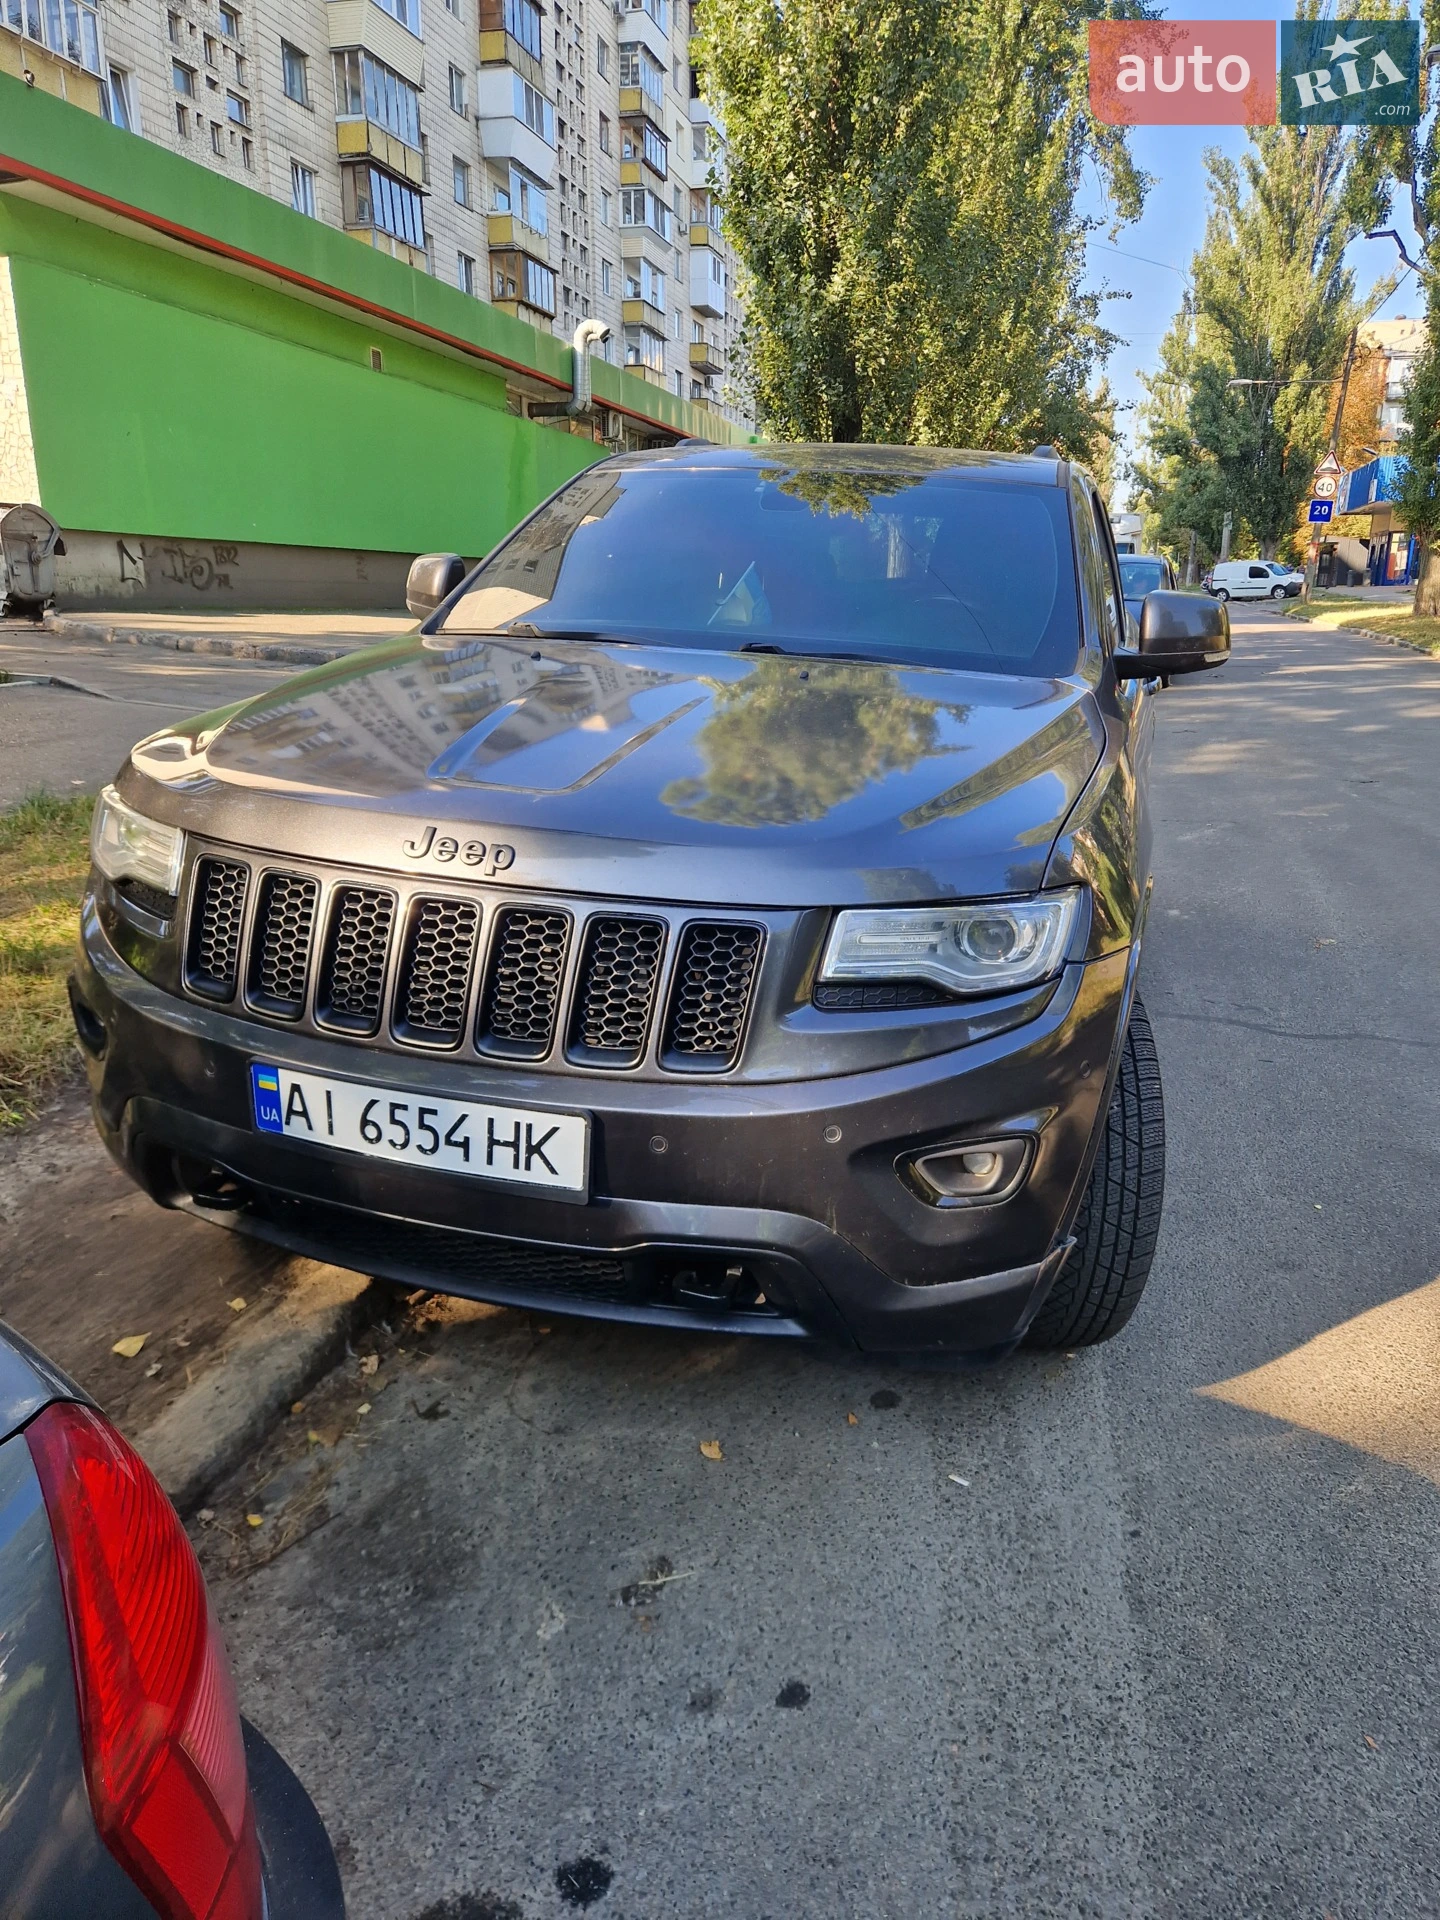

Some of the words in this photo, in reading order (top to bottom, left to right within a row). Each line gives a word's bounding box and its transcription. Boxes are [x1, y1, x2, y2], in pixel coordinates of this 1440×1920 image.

[1317, 483, 1333, 492] 40
[1313, 505, 1329, 515] 20
[402, 825, 516, 876] Jeep
[261, 1105, 279, 1123] UA
[285, 1082, 335, 1135] AI
[360, 1099, 470, 1162] 6554
[487, 1117, 560, 1175] HK
